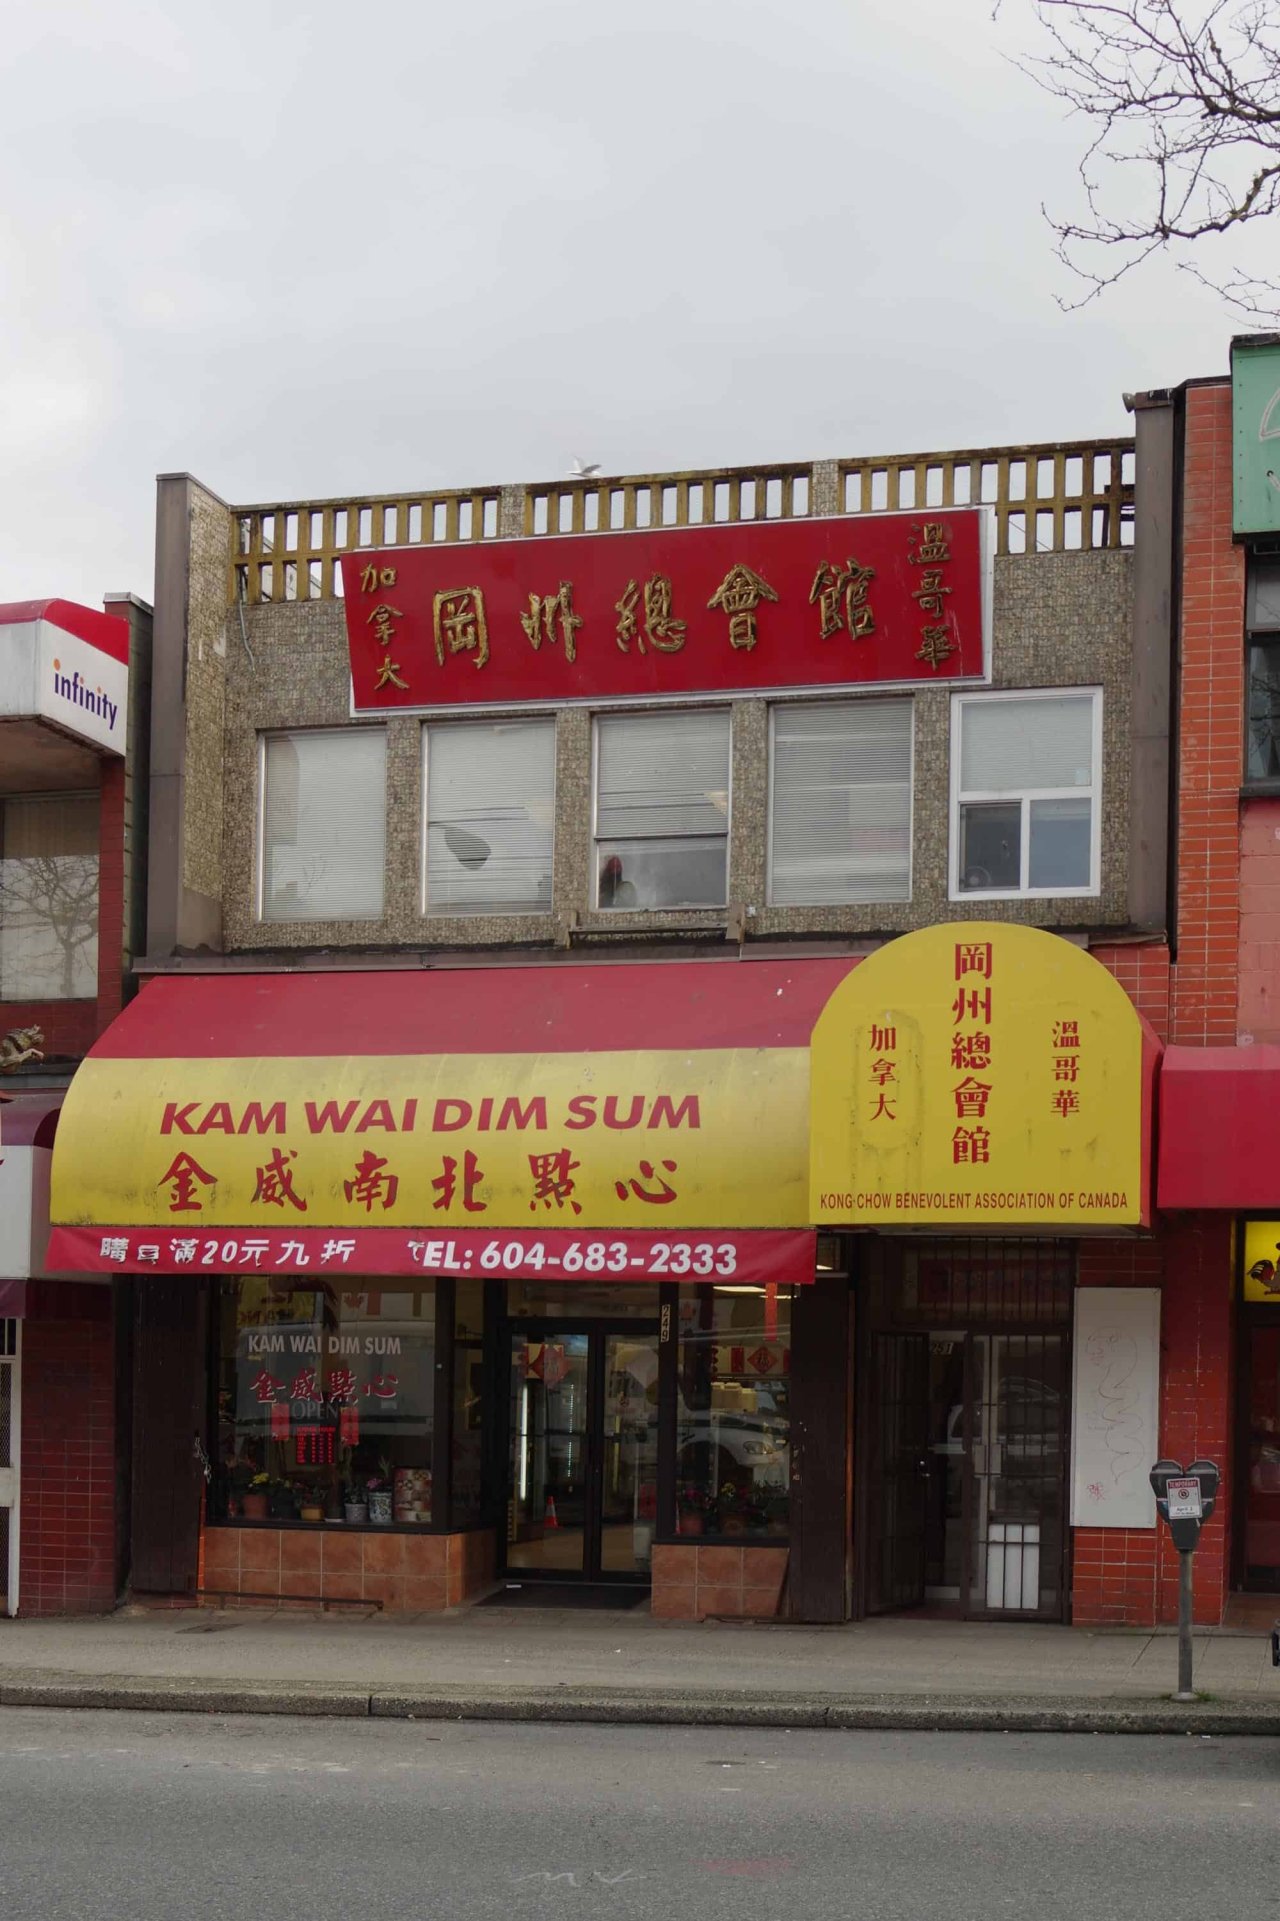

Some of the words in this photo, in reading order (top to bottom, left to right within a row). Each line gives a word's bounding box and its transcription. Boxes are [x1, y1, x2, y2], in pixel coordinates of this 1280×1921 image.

[361, 562, 409, 690] 加拿大
[53, 658, 117, 730] infinity
[868, 1023, 897, 1121] 加拿大
[950, 942, 993, 1165] 岡州總會館
[1051, 1020, 1081, 1118] 溫哥華
[161, 1100, 286, 1135] KAM
[306, 1099, 416, 1132] WAI
[432, 1097, 548, 1131] DIM
[565, 1095, 700, 1131] SUM
[157, 1148, 677, 1216] 金威南北點心
[821, 1193, 852, 1209] KONG
[857, 1193, 891, 1209] CHOW
[896, 1193, 971, 1209] BENEVOLENT
[975, 1193, 1055, 1209] ASSOCIATION
[1059, 1193, 1074, 1208] OF
[1079, 1193, 1128, 1208] CANADA
[248, 1335, 285, 1353] KAM
[289, 1336, 321, 1353] WAI
[328, 1336, 360, 1354] DIM
[365, 1337, 401, 1355] SUM
[661, 1305, 670, 1341] 249
[292, 1402, 339, 1420] OPEN
